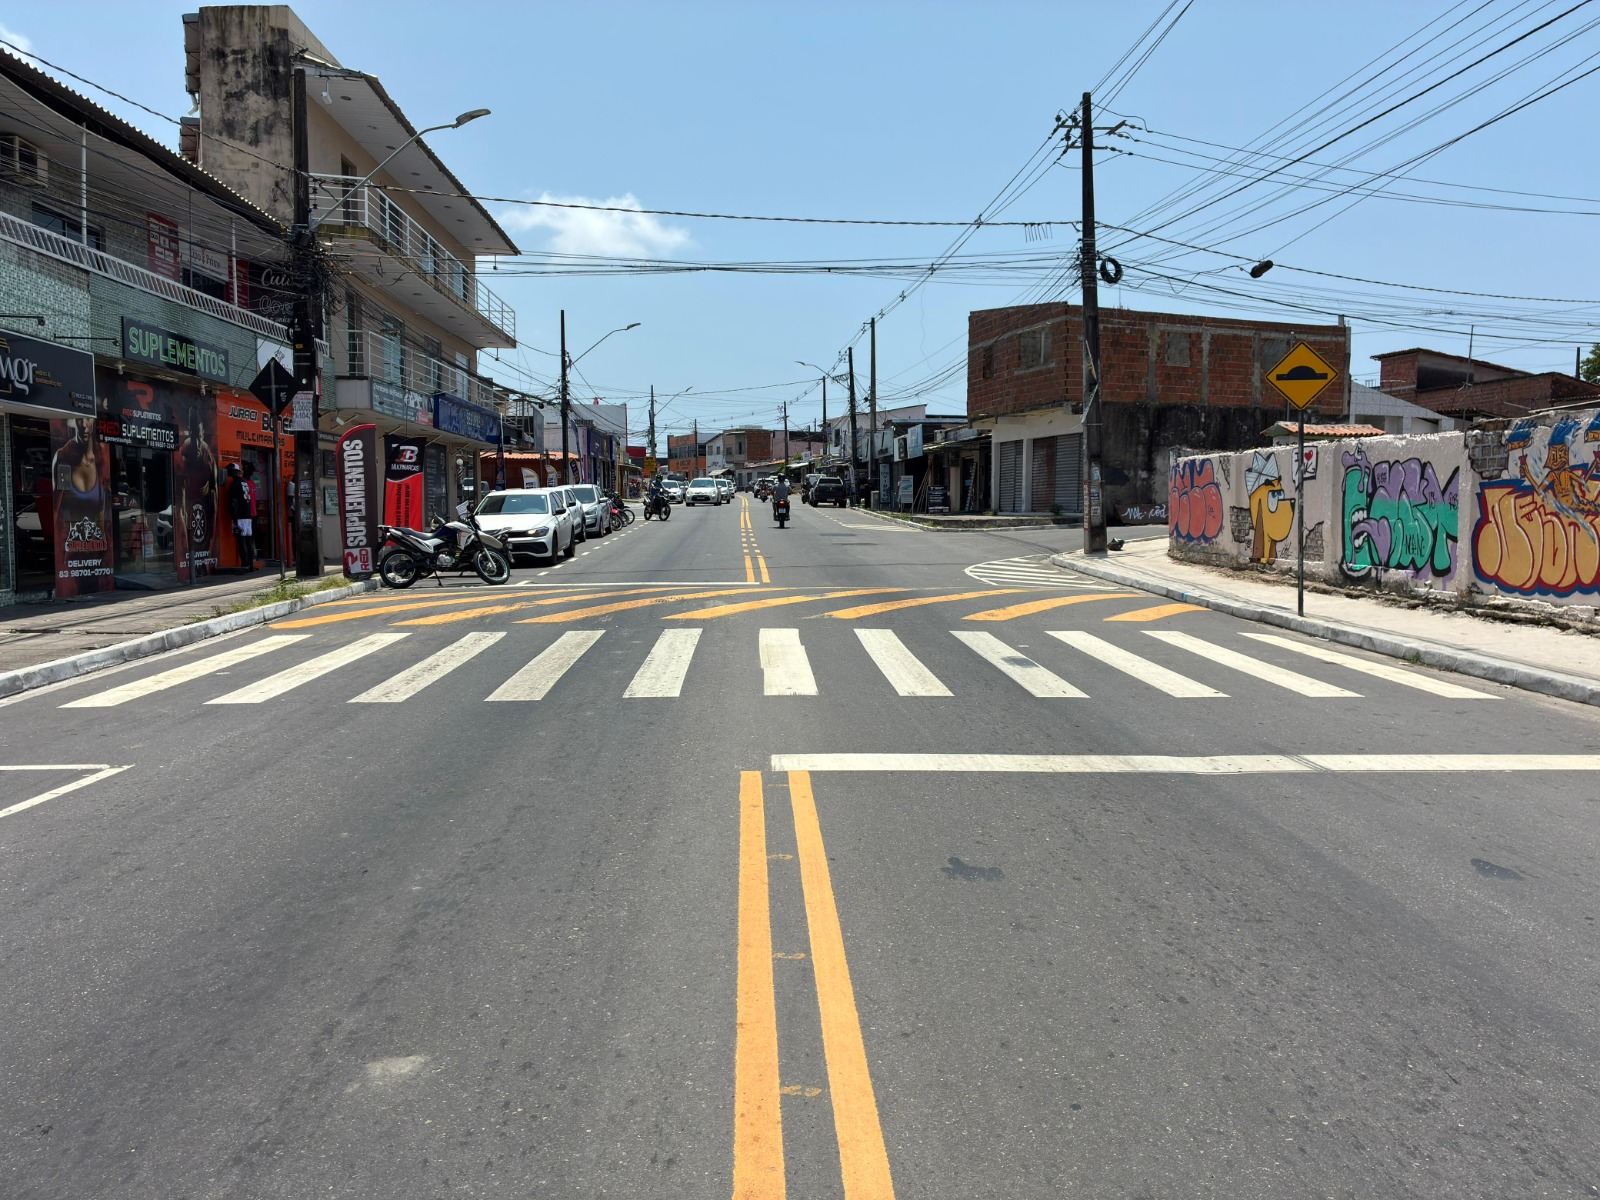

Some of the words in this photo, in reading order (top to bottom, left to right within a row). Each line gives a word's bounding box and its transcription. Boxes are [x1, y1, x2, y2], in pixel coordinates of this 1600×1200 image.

[128, 326, 226, 377] SUPLEMENTOS
[228, 405, 259, 422] JURACI
[97, 420, 122, 436] RED
[121, 423, 175, 442] SUPLEMENTOS
[342, 439, 367, 547] SUPLEMENTOS
[67, 558, 102, 568] DELIVERY
[359, 548, 370, 571] RED
[59, 570, 69, 578] 83
